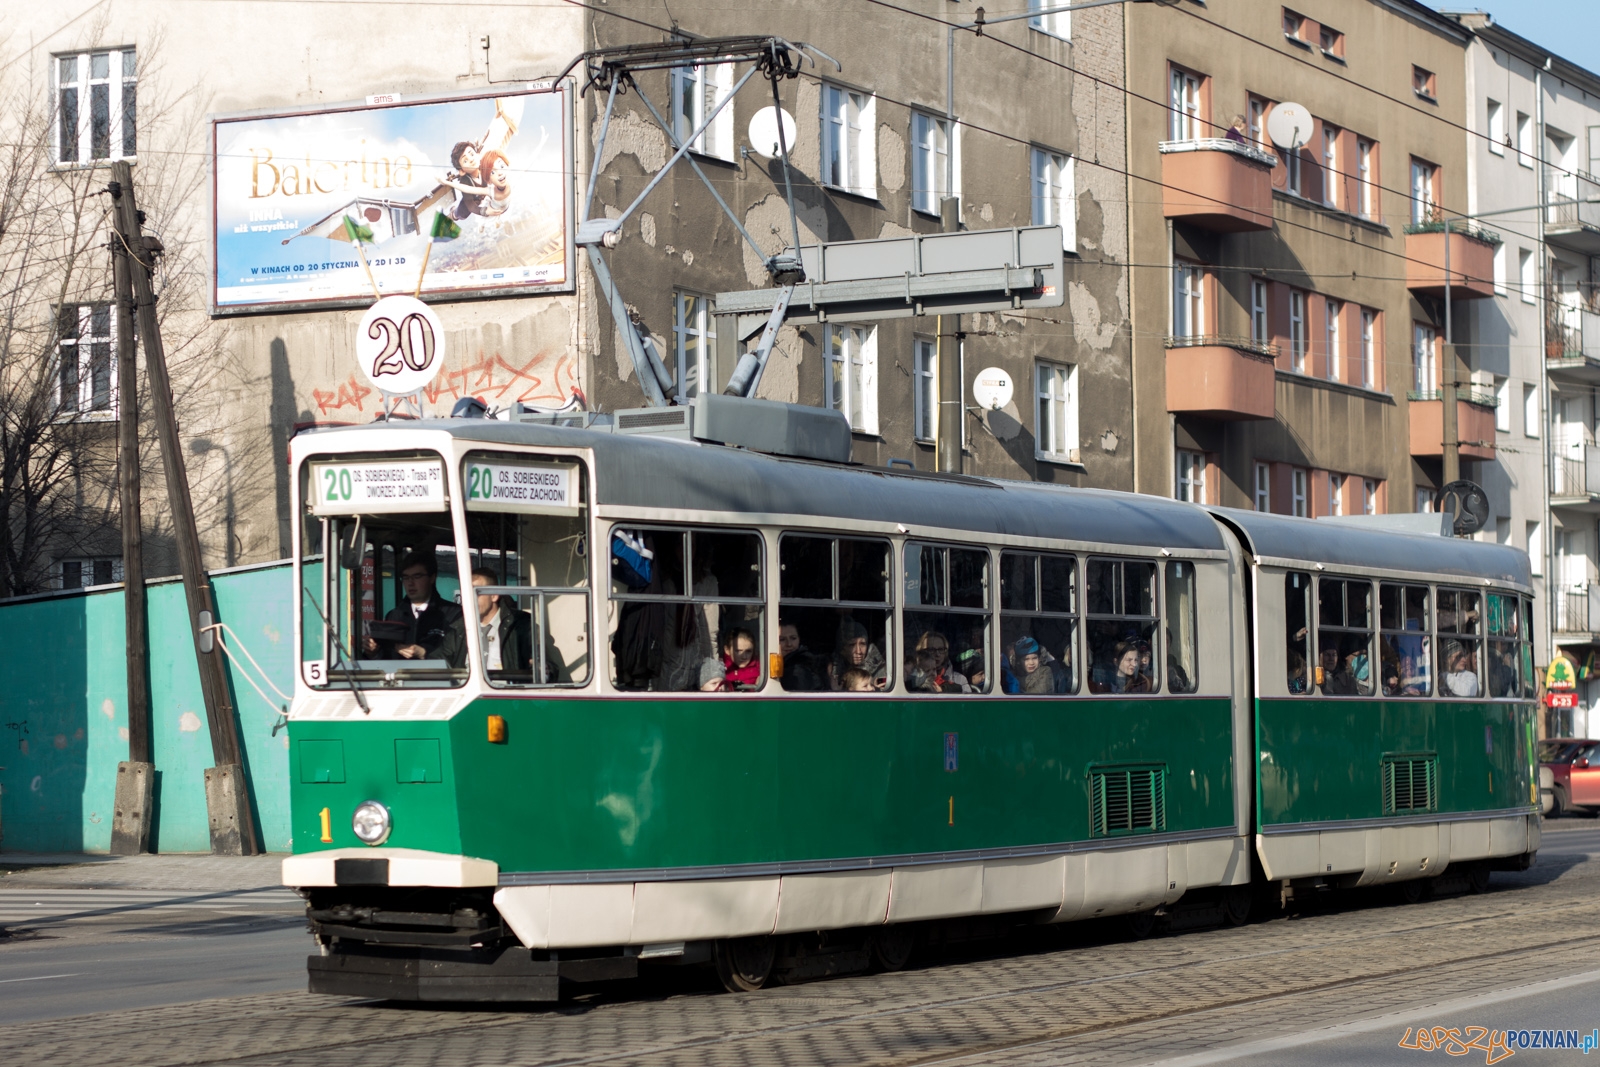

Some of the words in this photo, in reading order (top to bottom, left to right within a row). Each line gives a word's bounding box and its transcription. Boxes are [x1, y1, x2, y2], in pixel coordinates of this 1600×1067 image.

[373, 94, 394, 104] ams
[248, 139, 413, 198] Balerina
[249, 208, 283, 222] INNA
[251, 220, 298, 233] wszystkie!
[251, 267, 259, 275] W
[261, 265, 291, 274] KINACH
[293, 264, 304, 272] OD
[308, 263, 319, 271] 20
[321, 260, 360, 270] STYCZNIA
[375, 258, 386, 267] 2D
[395, 257, 406, 265] 3D
[368, 313, 436, 378] 20
[365, 468, 405, 482] SOBIESKIEGO
[428, 467, 441, 481] PST
[469, 467, 493, 499] 20
[498, 470, 511, 483] OS.
[513, 471, 560, 487] SOBIESKIEGO
[324, 468, 352, 501] 20
[367, 485, 396, 498] DWORZEC
[398, 484, 429, 497] ZACHODNI
[493, 486, 527, 499] DWORZEC
[529, 487, 565, 502] ZACHODNI
[311, 663, 321, 680] 5
[1552, 697, 1572, 708] 6-23
[319, 807, 333, 843] 1
